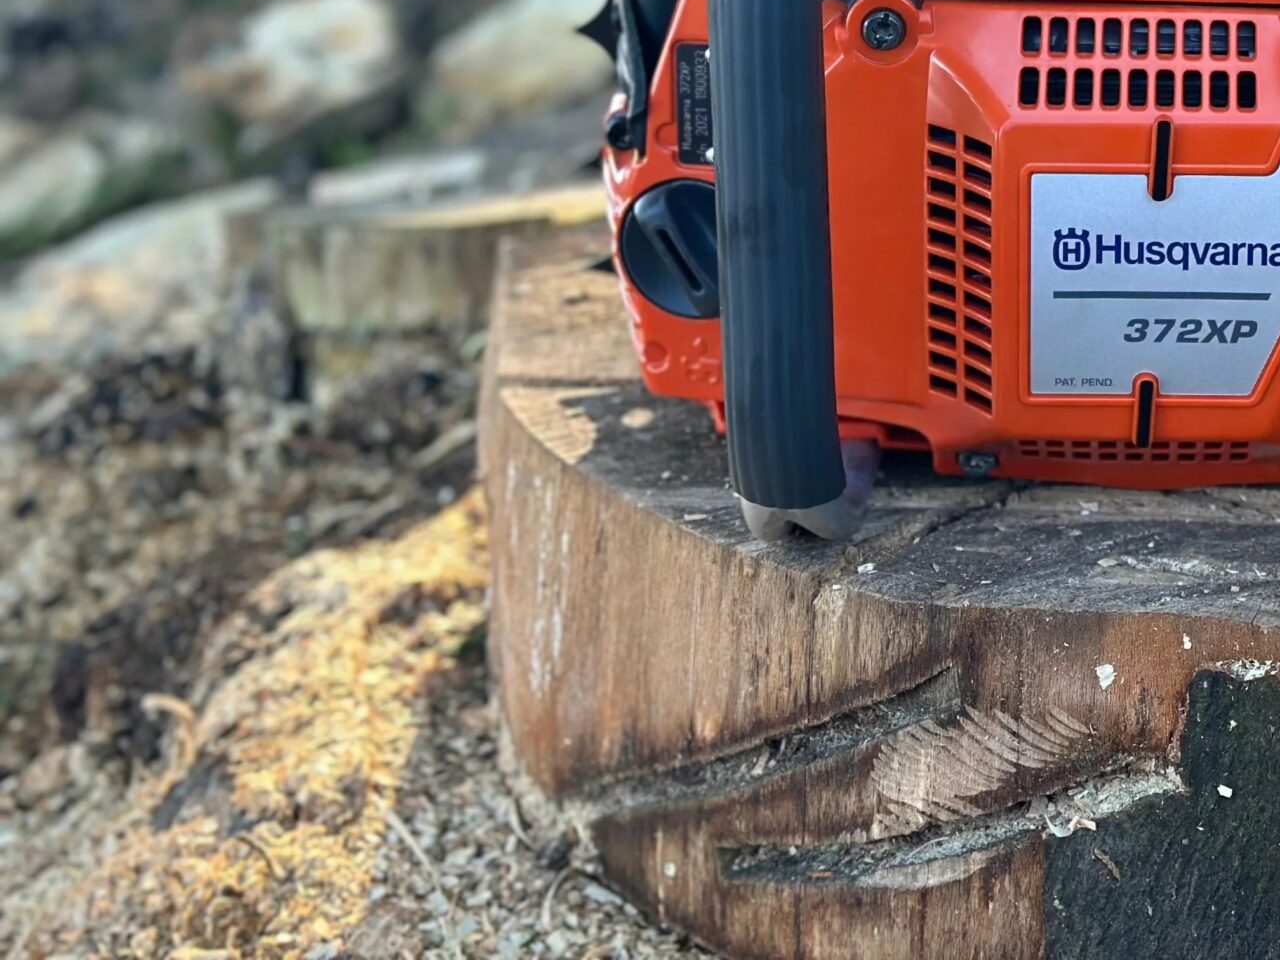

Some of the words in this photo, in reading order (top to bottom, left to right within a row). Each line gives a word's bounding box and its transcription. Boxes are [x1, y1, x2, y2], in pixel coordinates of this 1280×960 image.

[695, 108, 708, 136] 2021
[1123, 318, 1258, 344] 372XP
[1081, 377, 1115, 388] PEND.
